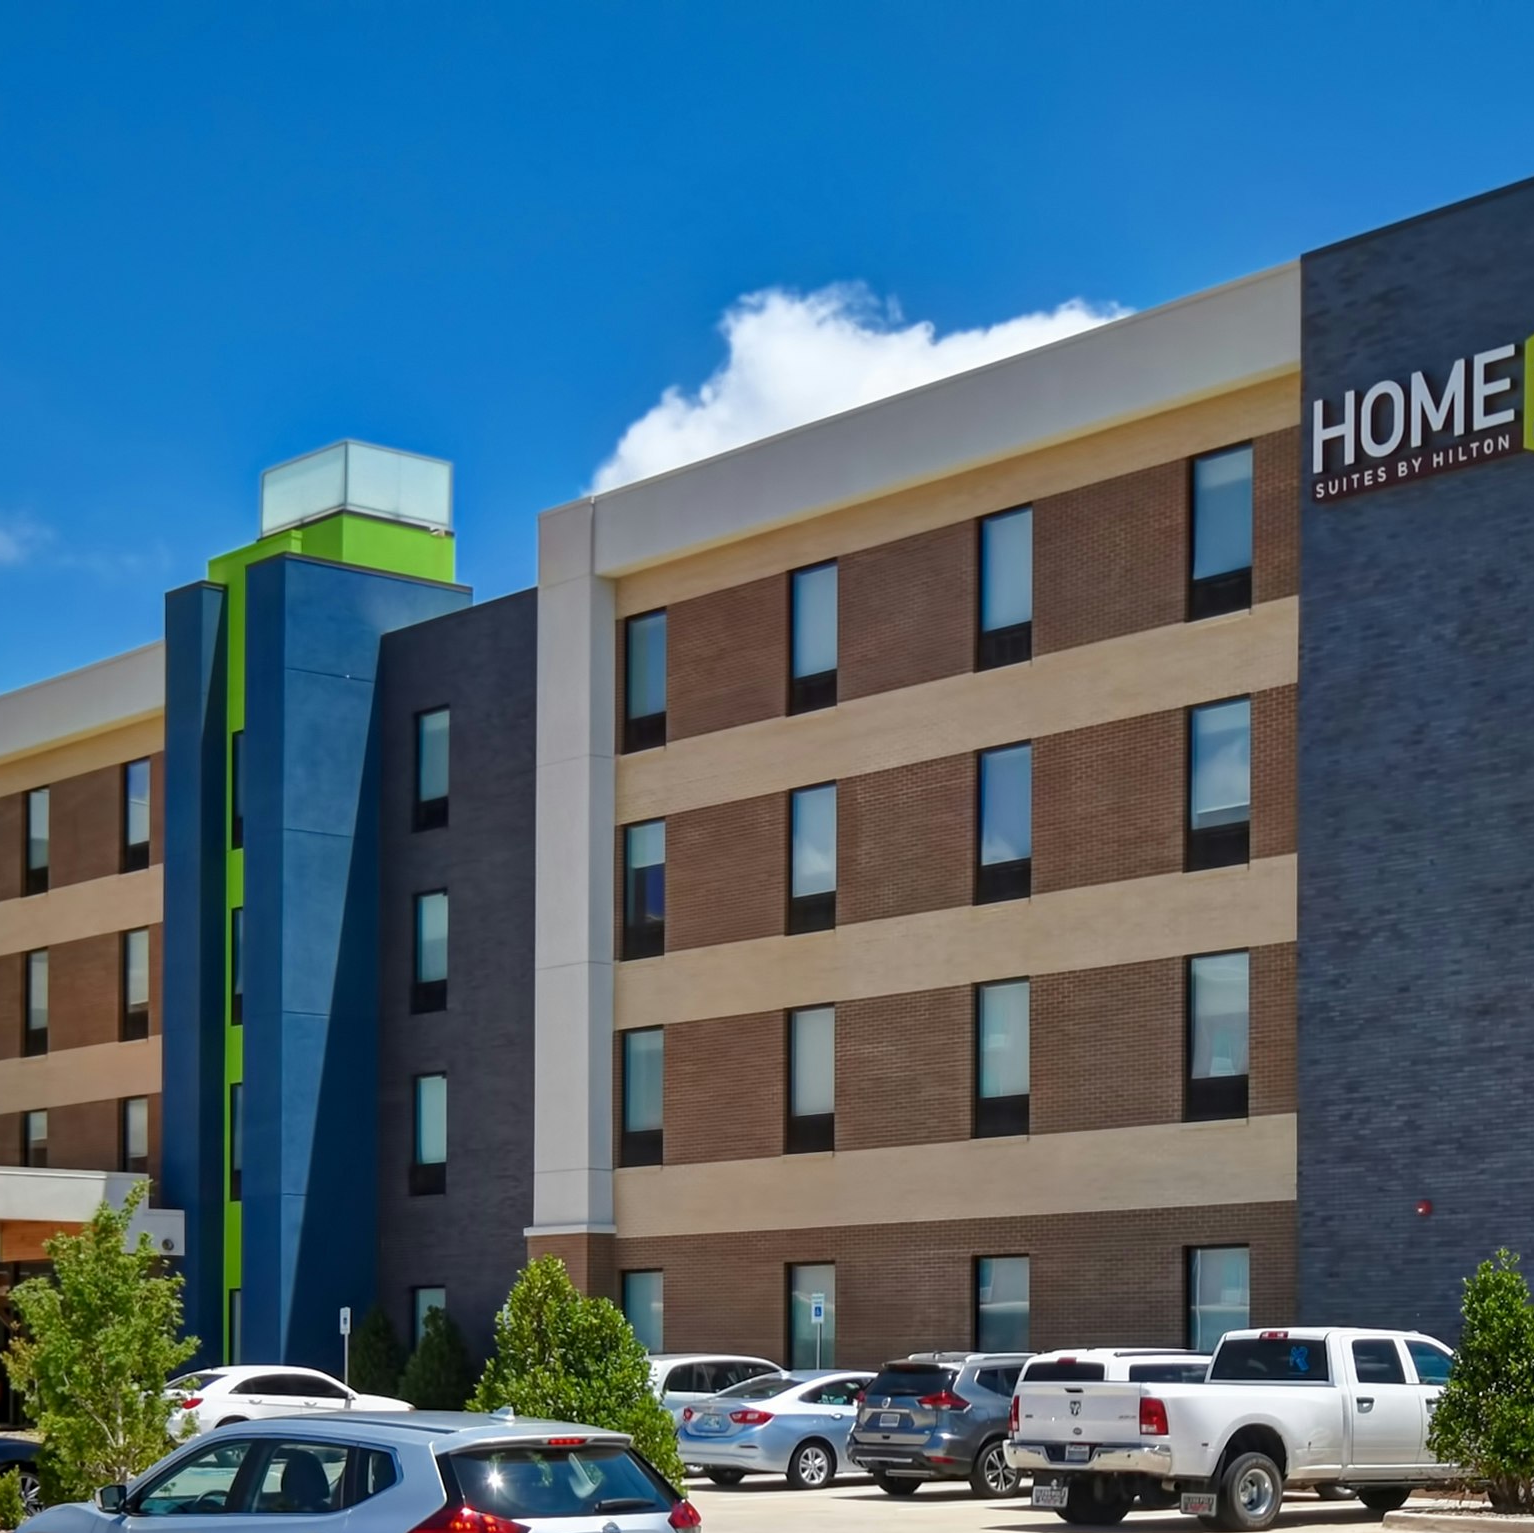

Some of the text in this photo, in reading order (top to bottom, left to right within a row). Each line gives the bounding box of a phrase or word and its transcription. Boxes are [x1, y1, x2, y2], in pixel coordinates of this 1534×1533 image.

[1313, 343, 1515, 474] HOME
[1315, 434, 1510, 498] SUITES BY HILTON
